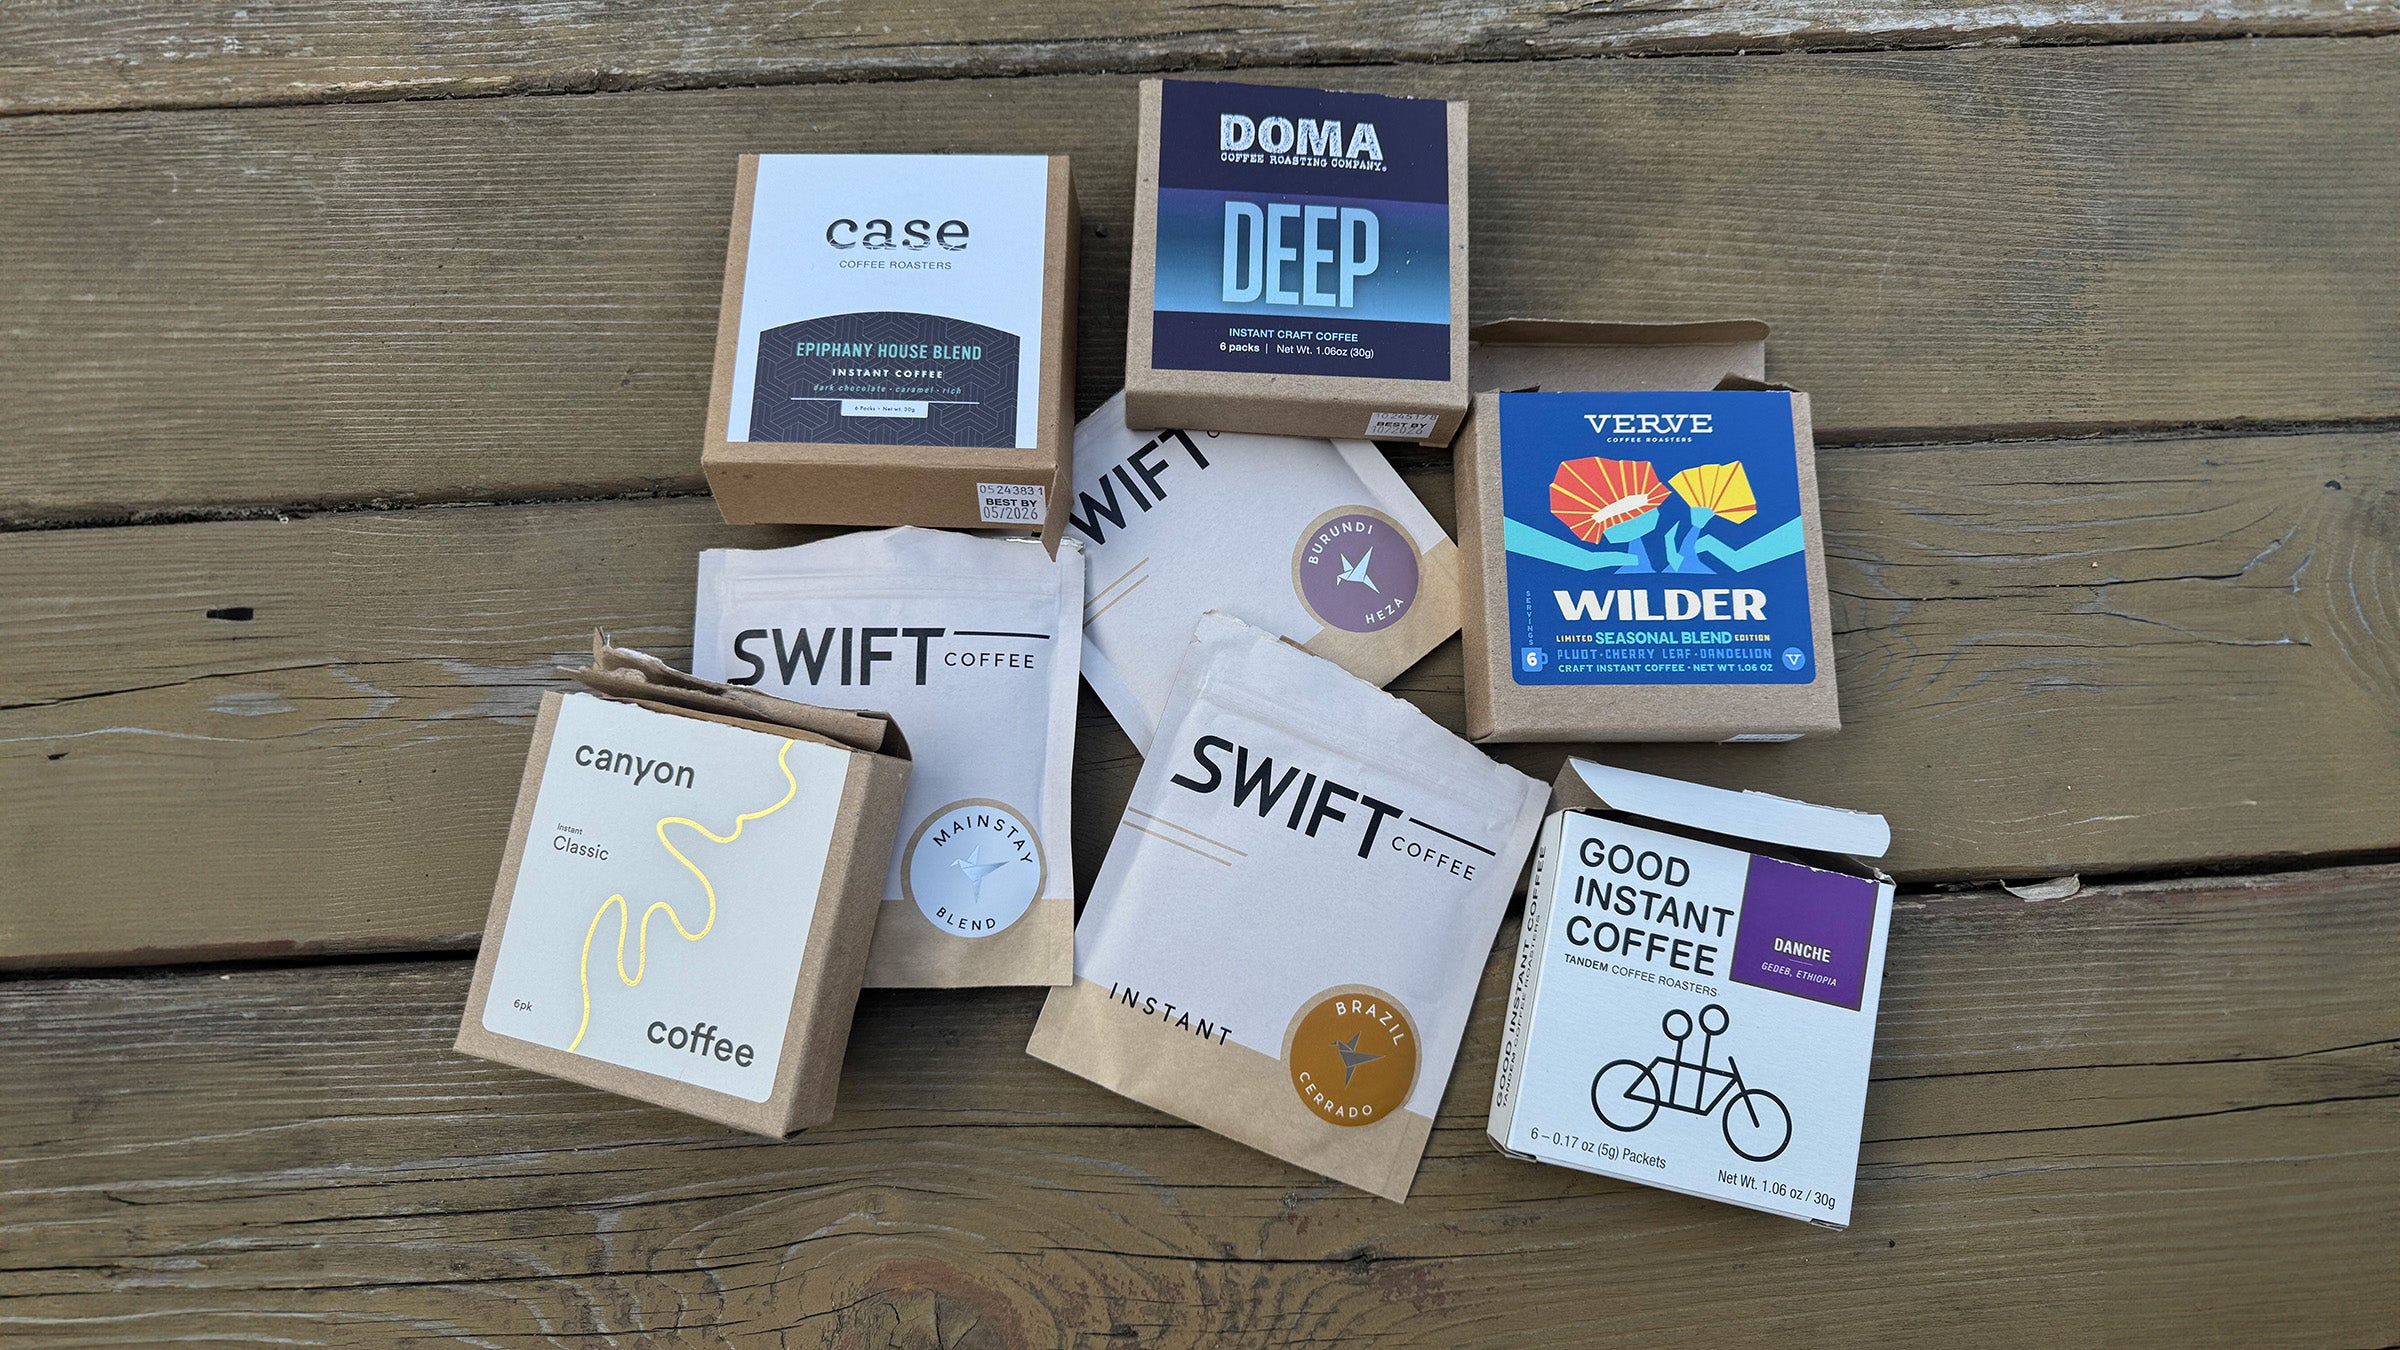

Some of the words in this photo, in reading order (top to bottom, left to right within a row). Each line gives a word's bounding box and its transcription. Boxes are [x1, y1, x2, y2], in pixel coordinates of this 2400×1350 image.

[1220, 113, 1384, 160] DOMA
[1220, 152, 1264, 164] COFFEE
[1269, 155, 1328, 168] ROASTING
[826, 217, 970, 251] case
[839, 260, 885, 270] COFFEE
[889, 260, 952, 270] ROASTERS
[1222, 200, 1380, 308] DEEP
[796, 342, 873, 358] EPIPHANY
[878, 344, 928, 359] HOUSE
[933, 345, 982, 360] BLEND
[1219, 342, 1226, 351] 6
[1229, 343, 1260, 353] packs
[1276, 344, 1294, 354] Net
[1296, 345, 1313, 355] Wt.
[1316, 346, 1348, 357] 1.06oz
[1350, 348, 1375, 360] (30g)
[1229, 328, 1274, 339] INSTANT
[1278, 330, 1313, 340] CRAFT
[1316, 332, 1359, 343] COFFEE
[813, 383, 834, 392] dark
[838, 384, 887, 393] chocolate
[895, 386, 934, 394] caramel
[942, 386, 962, 394] rich
[832, 368, 890, 378] INSTANT
[895, 370, 943, 379] COFFEE
[1583, 413, 1713, 434] VERVE
[985, 498, 1018, 507] BEST
[1021, 499, 1037, 507] BY
[1069, 429, 1210, 545] WIFT
[983, 506, 1038, 520] 05/2026
[1308, 520, 1374, 566] BURUNDI
[1365, 597, 1405, 625] HEZA
[1525, 590, 1534, 646] SERVINGS
[1553, 589, 1767, 621] WILDER
[1556, 635, 1593, 643] LIMITED
[1595, 632, 1678, 644] SEASONAL
[1681, 631, 1733, 644] BLEND
[727, 627, 945, 686] SWIFT
[944, 652, 1035, 669] COFFEE
[1526, 652, 1538, 667] 6
[1559, 664, 1593, 672] CRAFT
[1596, 664, 1641, 672] INSTANT
[1645, 664, 1685, 672] COFFEE
[1693, 664, 1714, 672] NET
[1717, 664, 1734, 672] WT
[1738, 664, 1757, 672] 1.06
[1760, 664, 1774, 672] OZ
[1605, 648, 1655, 660] CHERRY
[1662, 648, 1691, 659] LEAF
[1700, 648, 1772, 659] DANDELION
[1785, 654, 1801, 666] V
[575, 743, 696, 789] canyon
[1170, 734, 1404, 859] SWIFT
[1391, 835, 1476, 881] COFFEE
[557, 823, 583, 835] Instant
[933, 814, 1033, 864] MAINSTAY
[553, 835, 609, 861] Classic
[1579, 837, 1690, 887] GOOD
[936, 906, 996, 931] BLEND
[1573, 876, 1735, 938] INSTANT
[1566, 915, 1719, 977] COFFEE
[1773, 937, 1831, 963] DANCHE
[1496, 1041, 1512, 1107] GOOD
[1509, 940, 1529, 1033] INSTANT
[1527, 846, 1546, 932] COFFEE
[1564, 953, 1608, 972] TANDEM
[1612, 965, 1655, 983] COFFEE
[1658, 975, 1718, 997] ROASTERS
[1761, 961, 1793, 978] GEDEB,
[1796, 968, 1837, 987] ETHIOPIA
[513, 998, 533, 1012] 6pk
[1109, 981, 1233, 1046] INSTANT
[1335, 999, 1405, 1046] BRAZIL
[647, 1020, 755, 1067] coffee
[1299, 1070, 1373, 1118] CERRADO
[1502, 1052, 1516, 1107] TANDEM
[1531, 1127, 1539, 1139] 6
[1553, 1132, 1579, 1148] 0.17
[1581, 1141, 1595, 1152] oz
[1598, 1142, 1620, 1160] (5g)
[1622, 1148, 1667, 1169] Packets
[1718, 1169, 1738, 1185] Net
[1740, 1174, 1758, 1190] Wt.
[1762, 1180, 1787, 1196] 1.06
[1789, 1188, 1803, 1200] oz
[1813, 1192, 1836, 1210] 30g
